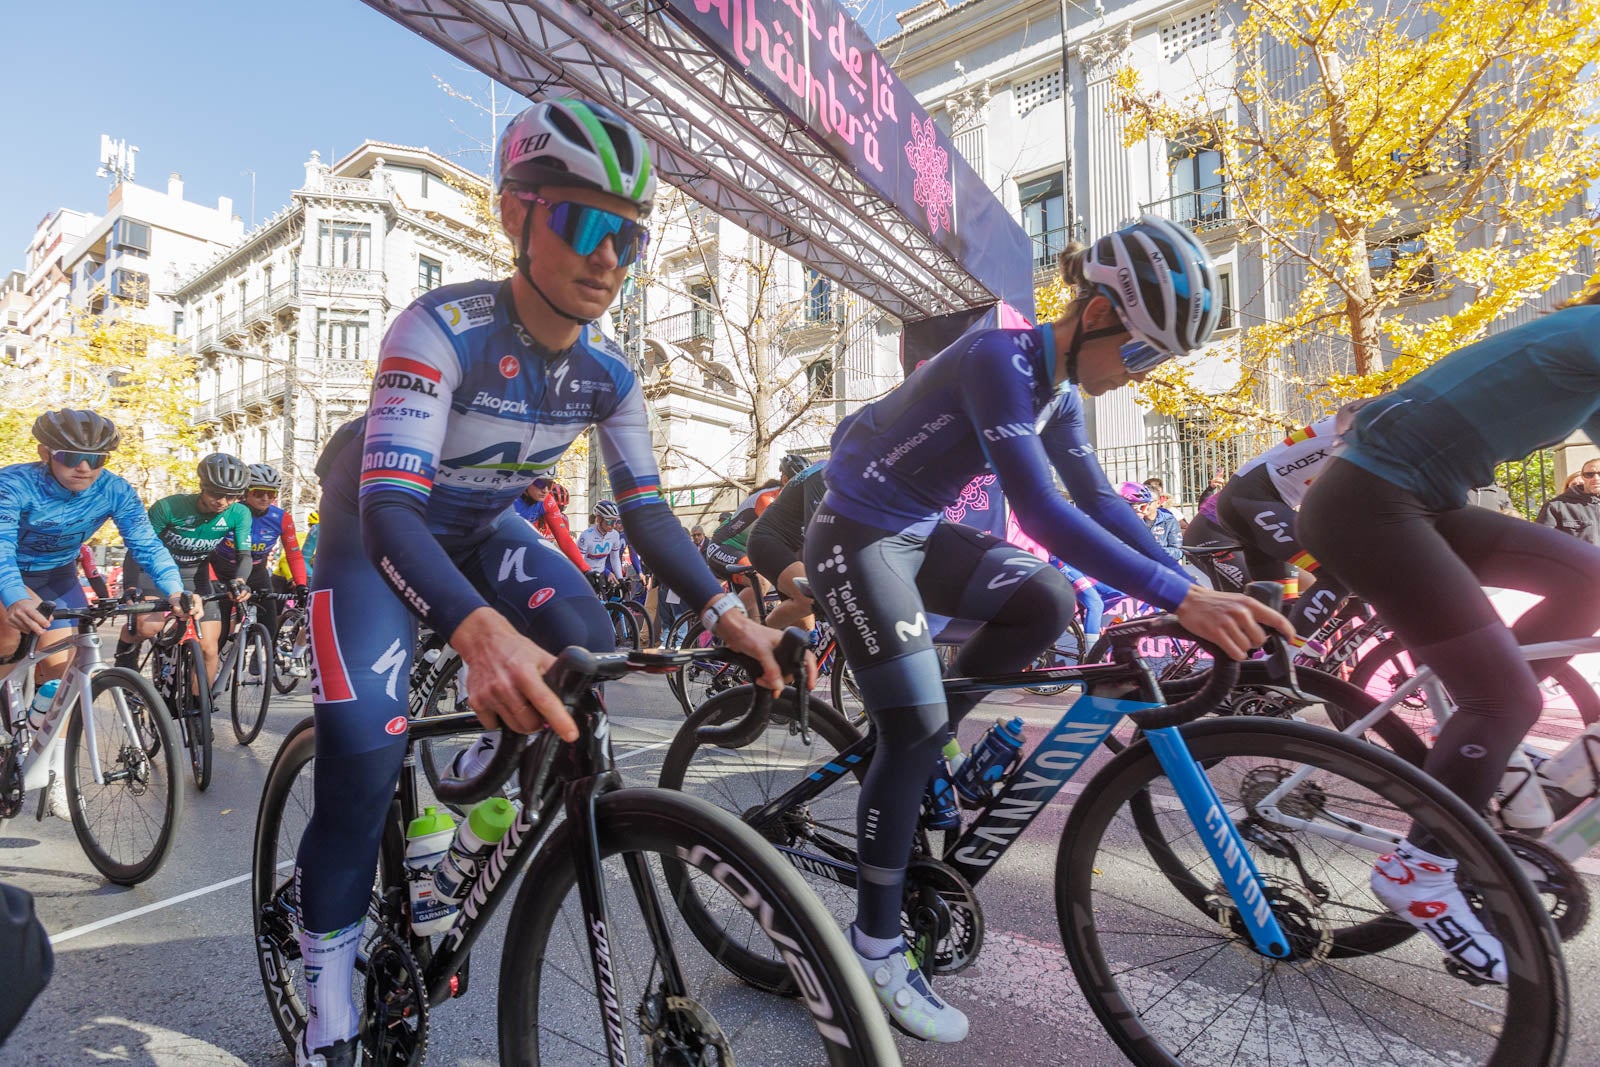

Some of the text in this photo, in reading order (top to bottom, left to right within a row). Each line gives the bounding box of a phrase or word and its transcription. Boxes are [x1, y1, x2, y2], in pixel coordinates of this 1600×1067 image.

[376, 373, 439, 399] OUDAL
[472, 391, 529, 415] Ekopak
[921, 414, 956, 434] Tech
[1275, 449, 1329, 477] CADEX
[826, 588, 847, 625] Tech
[837, 580, 881, 656] Telefónica
[954, 721, 1111, 868] CANYON
[1203, 804, 1273, 929] CANYON
[418, 908, 450, 921] GARMIN
[590, 912, 629, 1067] SPECIALIZE
